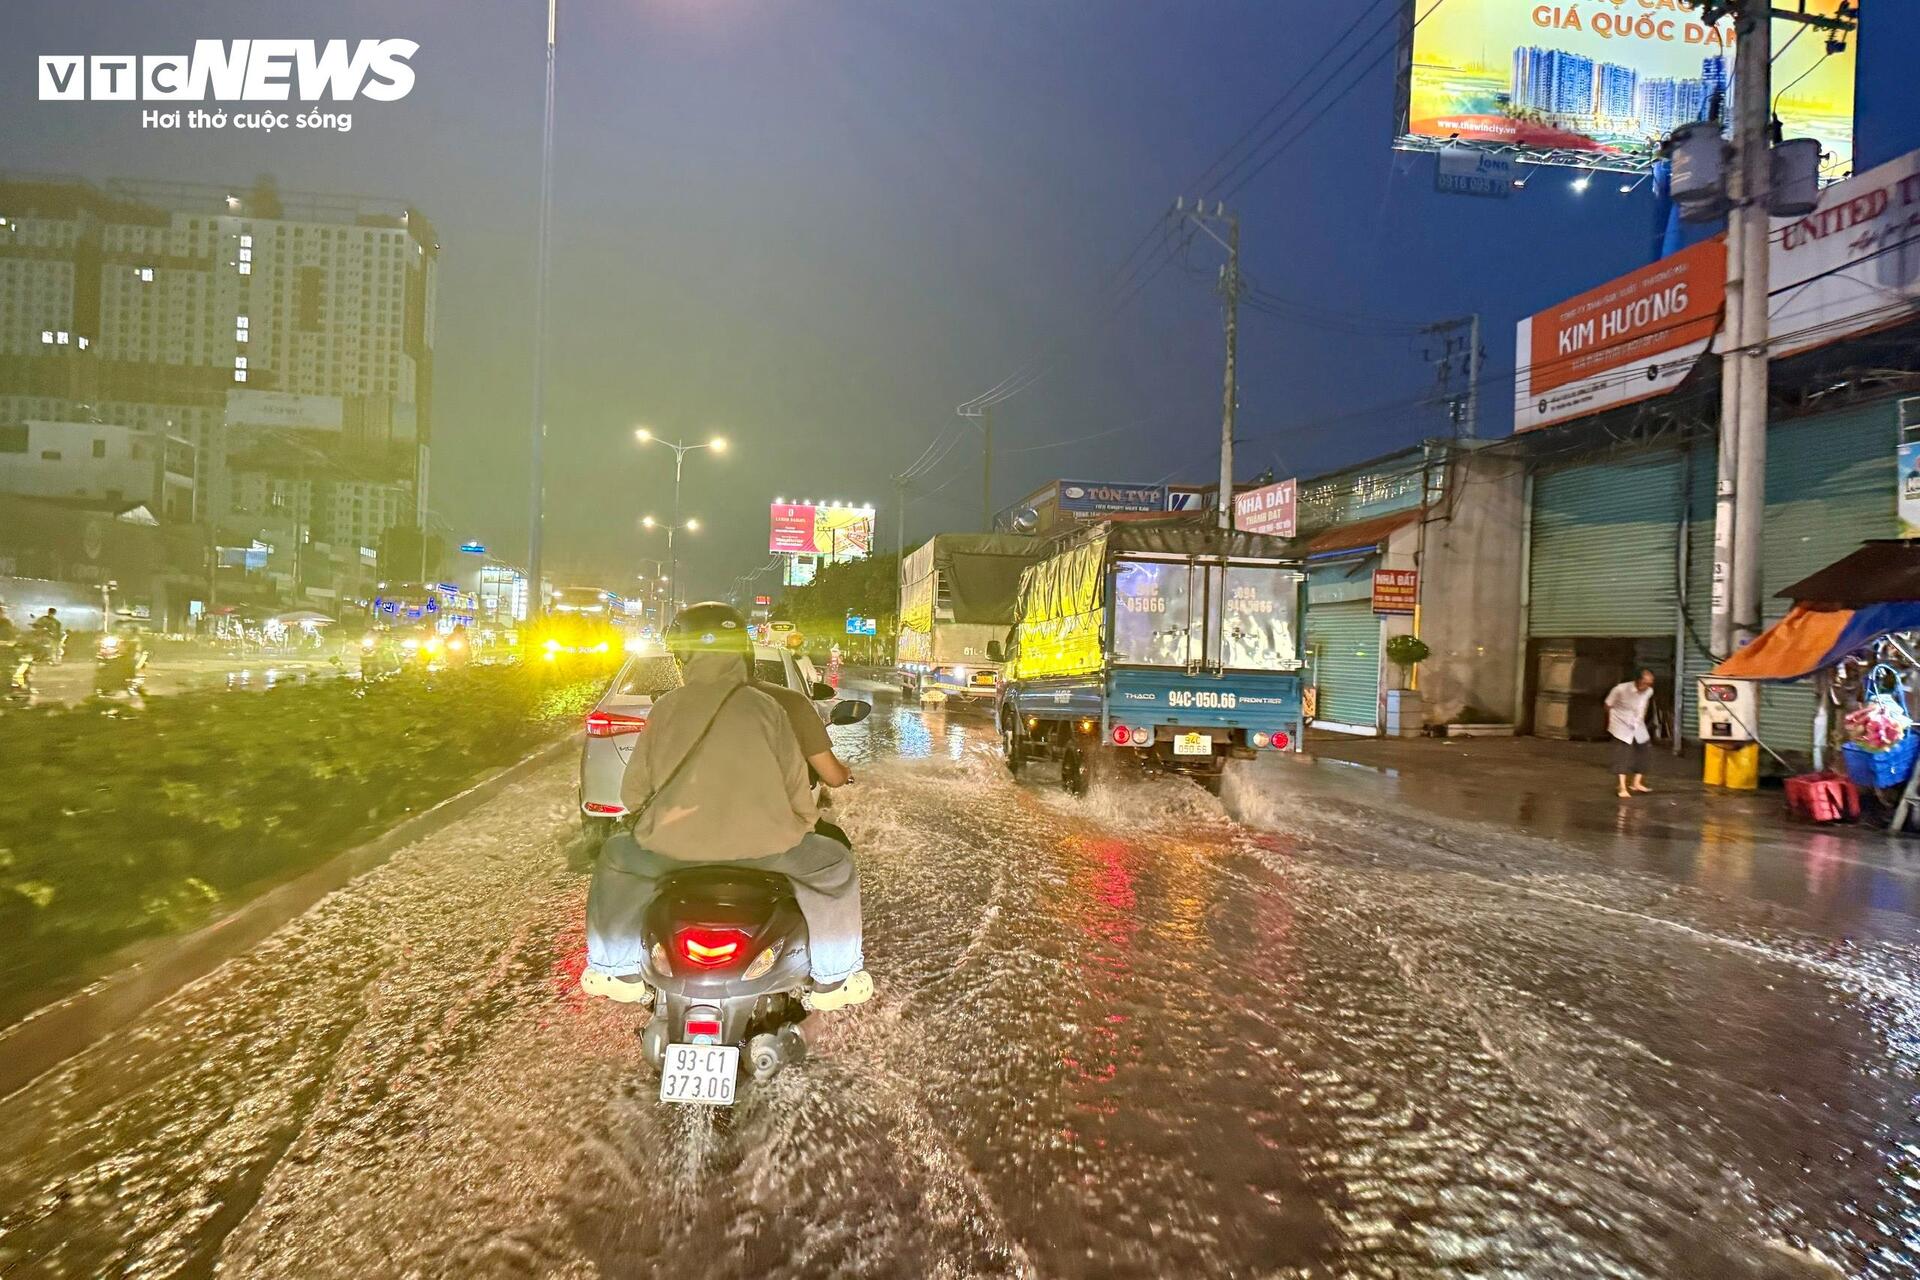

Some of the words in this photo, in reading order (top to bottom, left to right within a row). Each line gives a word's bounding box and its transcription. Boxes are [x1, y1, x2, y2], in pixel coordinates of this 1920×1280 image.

[1532, 4, 1582, 31] GIÁ
[1591, 11, 1675, 42] QUỐC
[1437, 120, 1516, 134] www.thewincity.vn
[1783, 188, 1888, 250] UNITED
[1558, 318, 1594, 356] KIM
[1601, 282, 1689, 340] HƯƠNG
[1087, 486, 1121, 502] TÔN
[1237, 492, 1264, 517] NHÀ
[1266, 483, 1292, 509] ĐẤT
[1124, 692, 1155, 700] THACO
[1168, 690, 1236, 708] 94C-050.66
[1239, 696, 1282, 705] FRONTIER
[676, 1049, 726, 1074] 93-C1
[666, 1074, 731, 1099] 373.06
